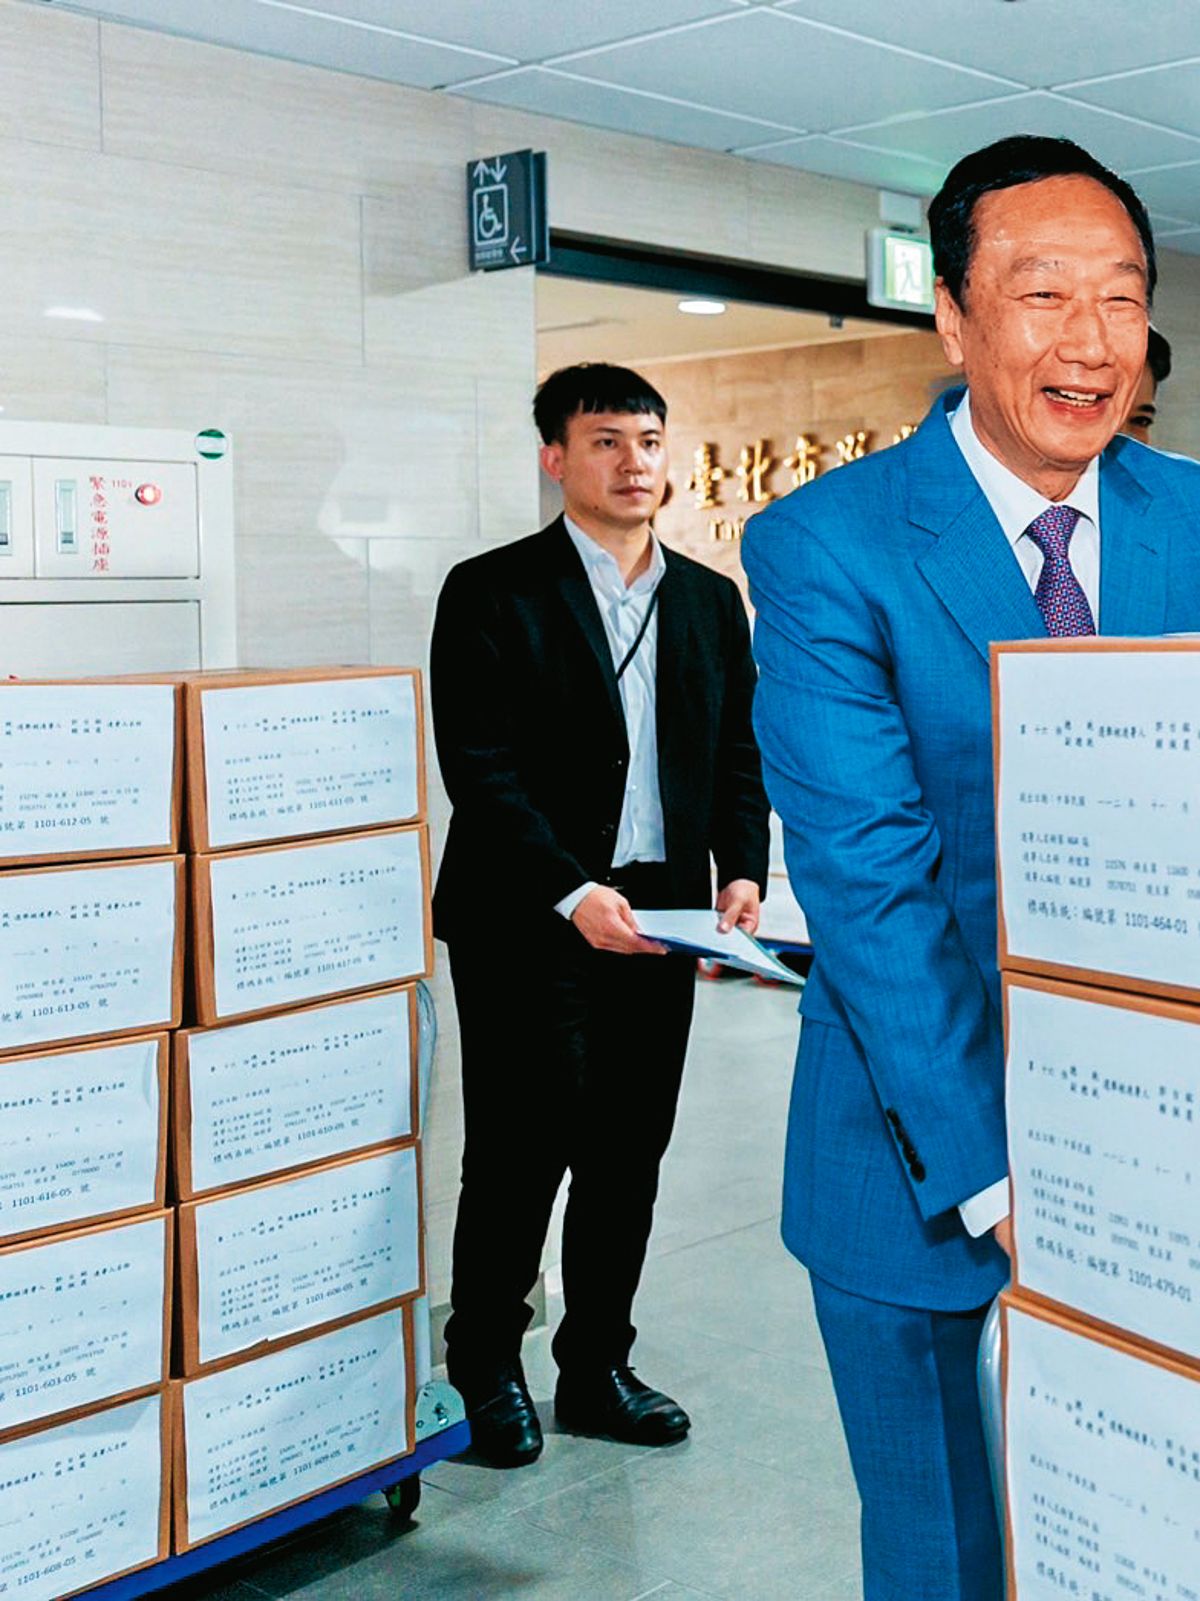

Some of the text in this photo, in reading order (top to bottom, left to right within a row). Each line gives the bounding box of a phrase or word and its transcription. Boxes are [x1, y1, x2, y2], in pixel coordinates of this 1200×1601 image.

[683, 425, 918, 510] 臺北市
[35, 817, 91, 828] 1101-612-05
[33, 1001, 90, 1017] 1101-613-05
